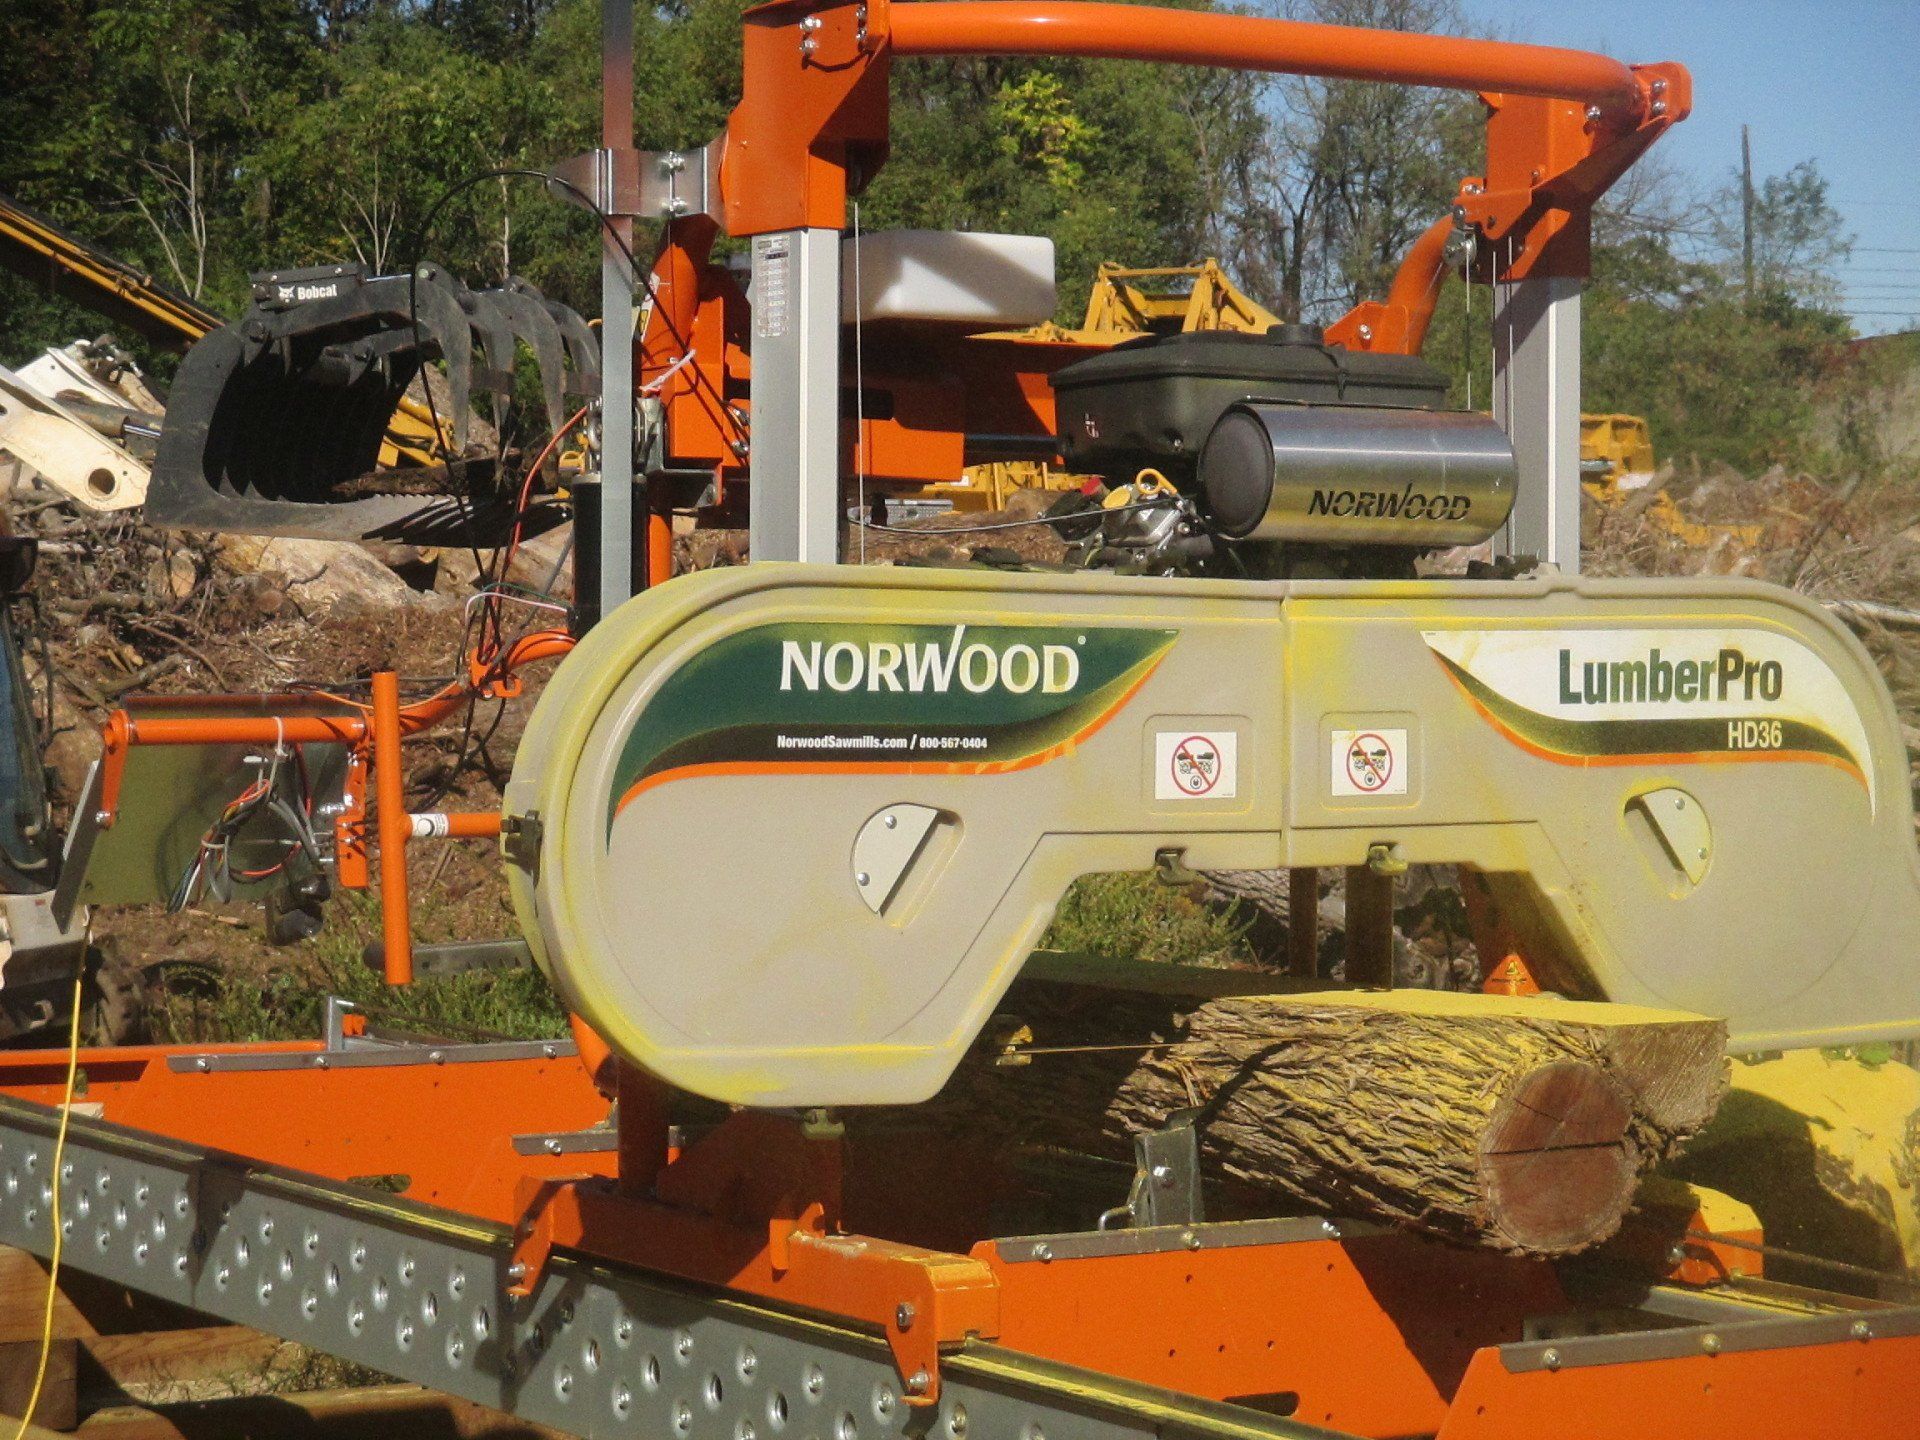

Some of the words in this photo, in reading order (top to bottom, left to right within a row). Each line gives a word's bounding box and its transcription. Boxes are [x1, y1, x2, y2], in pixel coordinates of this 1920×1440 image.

[297, 284, 337, 300] Bobcat
[1307, 481, 1471, 520] NORWOOD
[780, 624, 1079, 693] NORWOOD
[1559, 648, 1783, 705] LumberPro
[777, 735, 907, 749] NorwoodSawmills.com
[919, 737, 987, 749] 800-567-0404
[1727, 721, 1783, 749] HD36
